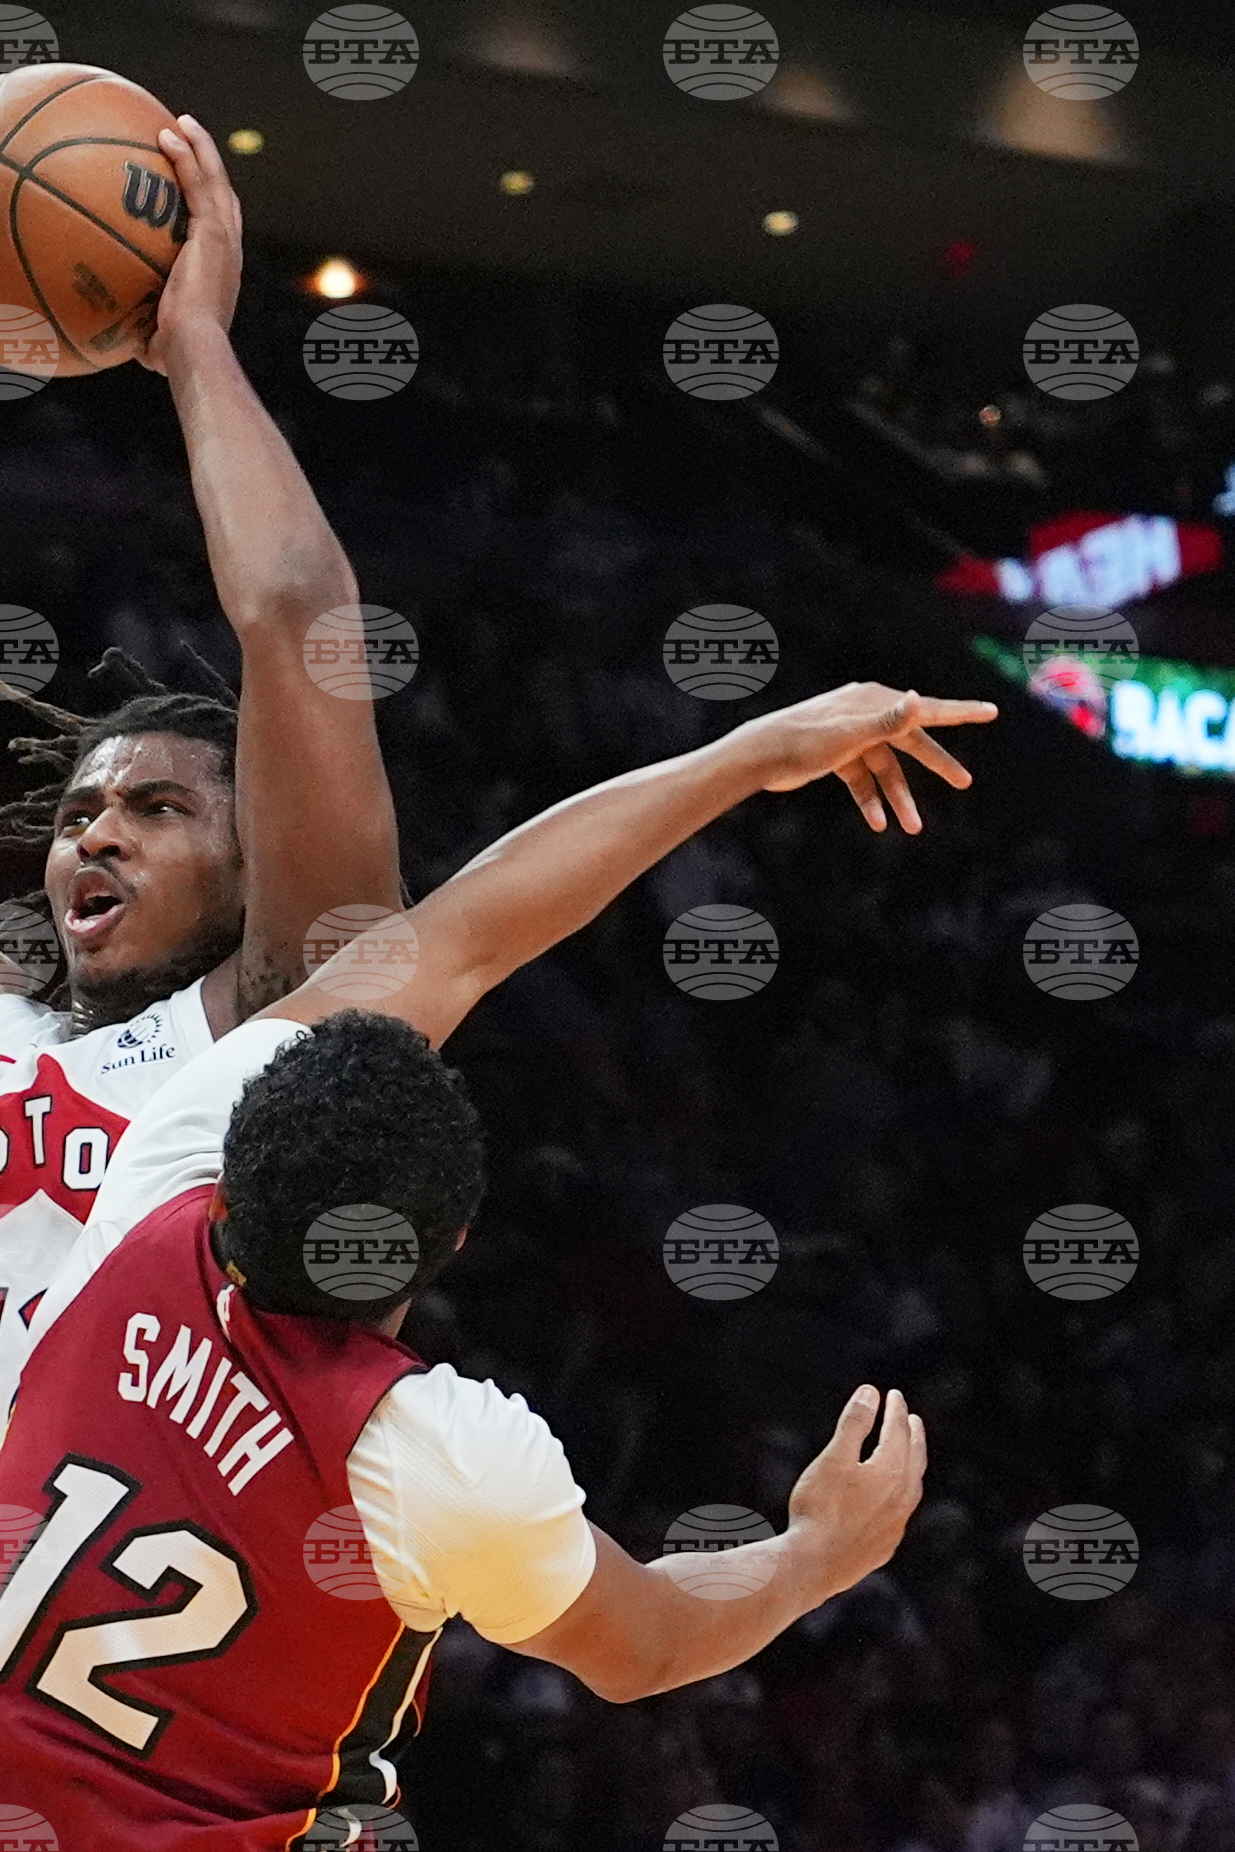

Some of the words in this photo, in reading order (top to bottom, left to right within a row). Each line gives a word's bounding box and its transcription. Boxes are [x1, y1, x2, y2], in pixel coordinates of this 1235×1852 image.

[1110, 680, 1235, 772] BAC
[101, 1056, 135, 1074] Sun
[139, 1043, 176, 1063] Life
[118, 1311, 295, 1497] SMITH
